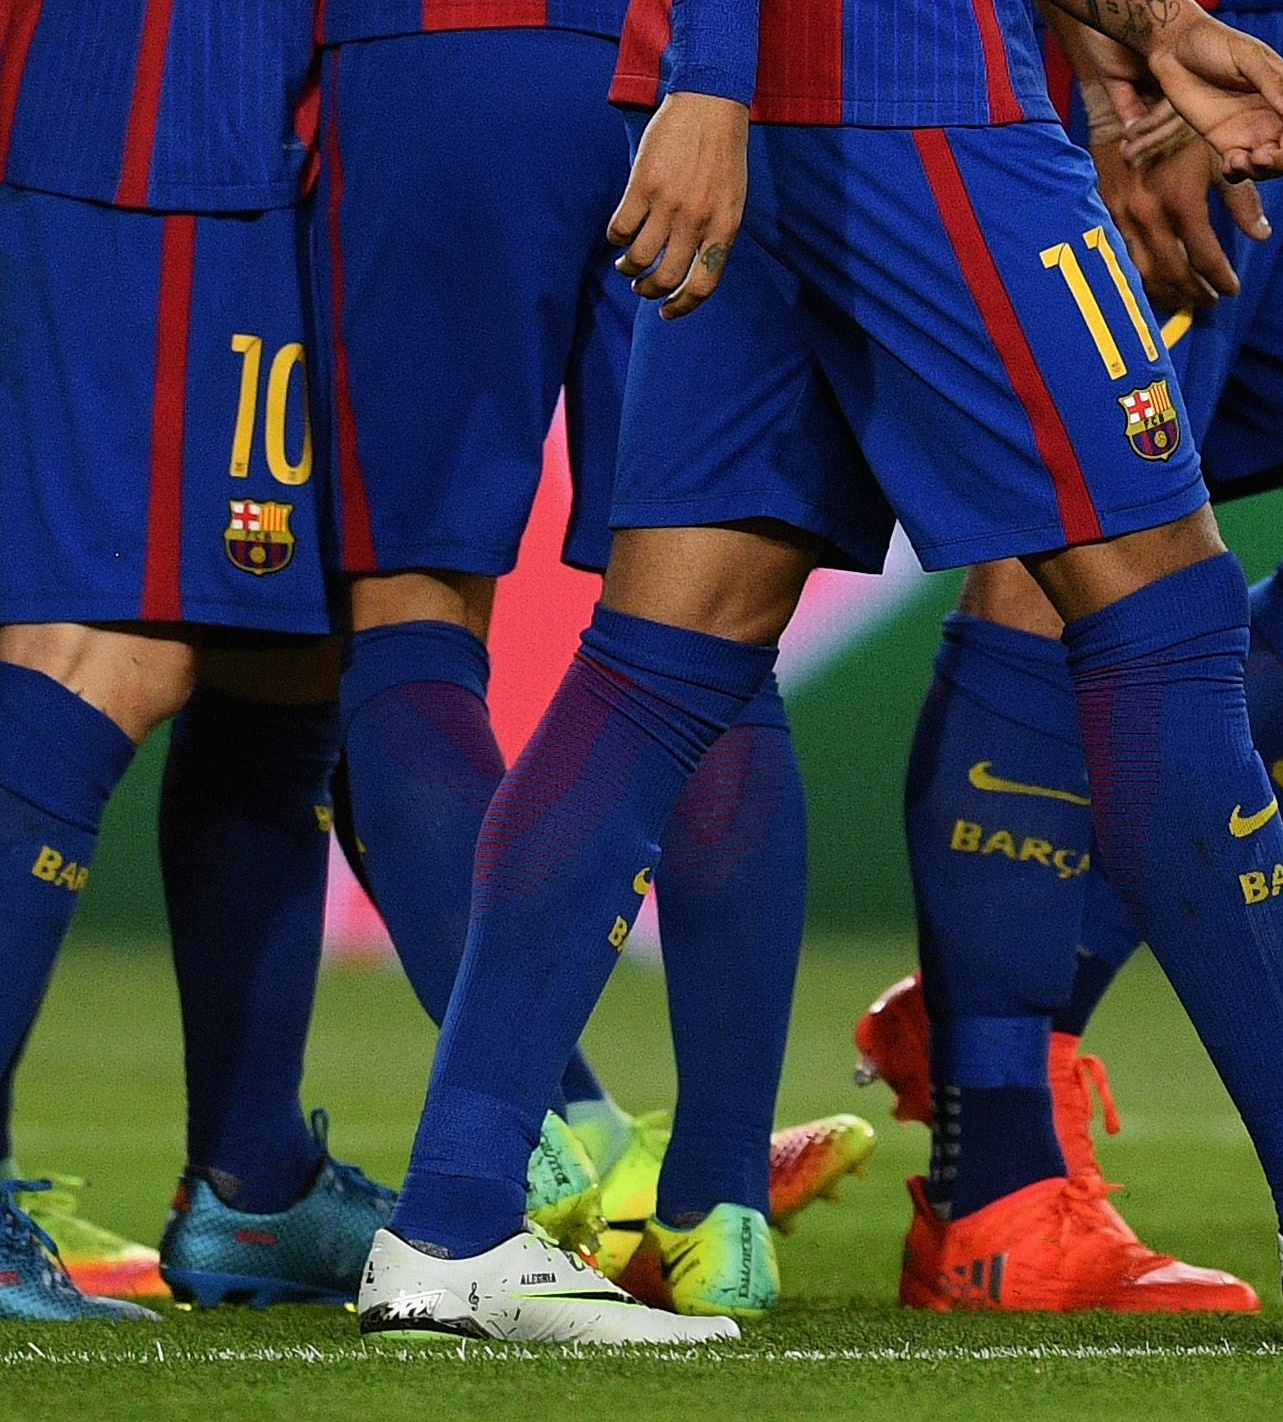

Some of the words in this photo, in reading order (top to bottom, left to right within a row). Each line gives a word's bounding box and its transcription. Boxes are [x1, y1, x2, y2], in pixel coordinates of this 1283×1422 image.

[1039, 225, 1160, 380] 11
[229, 334, 314, 486] 10
[1143, 412, 1165, 430] FCB
